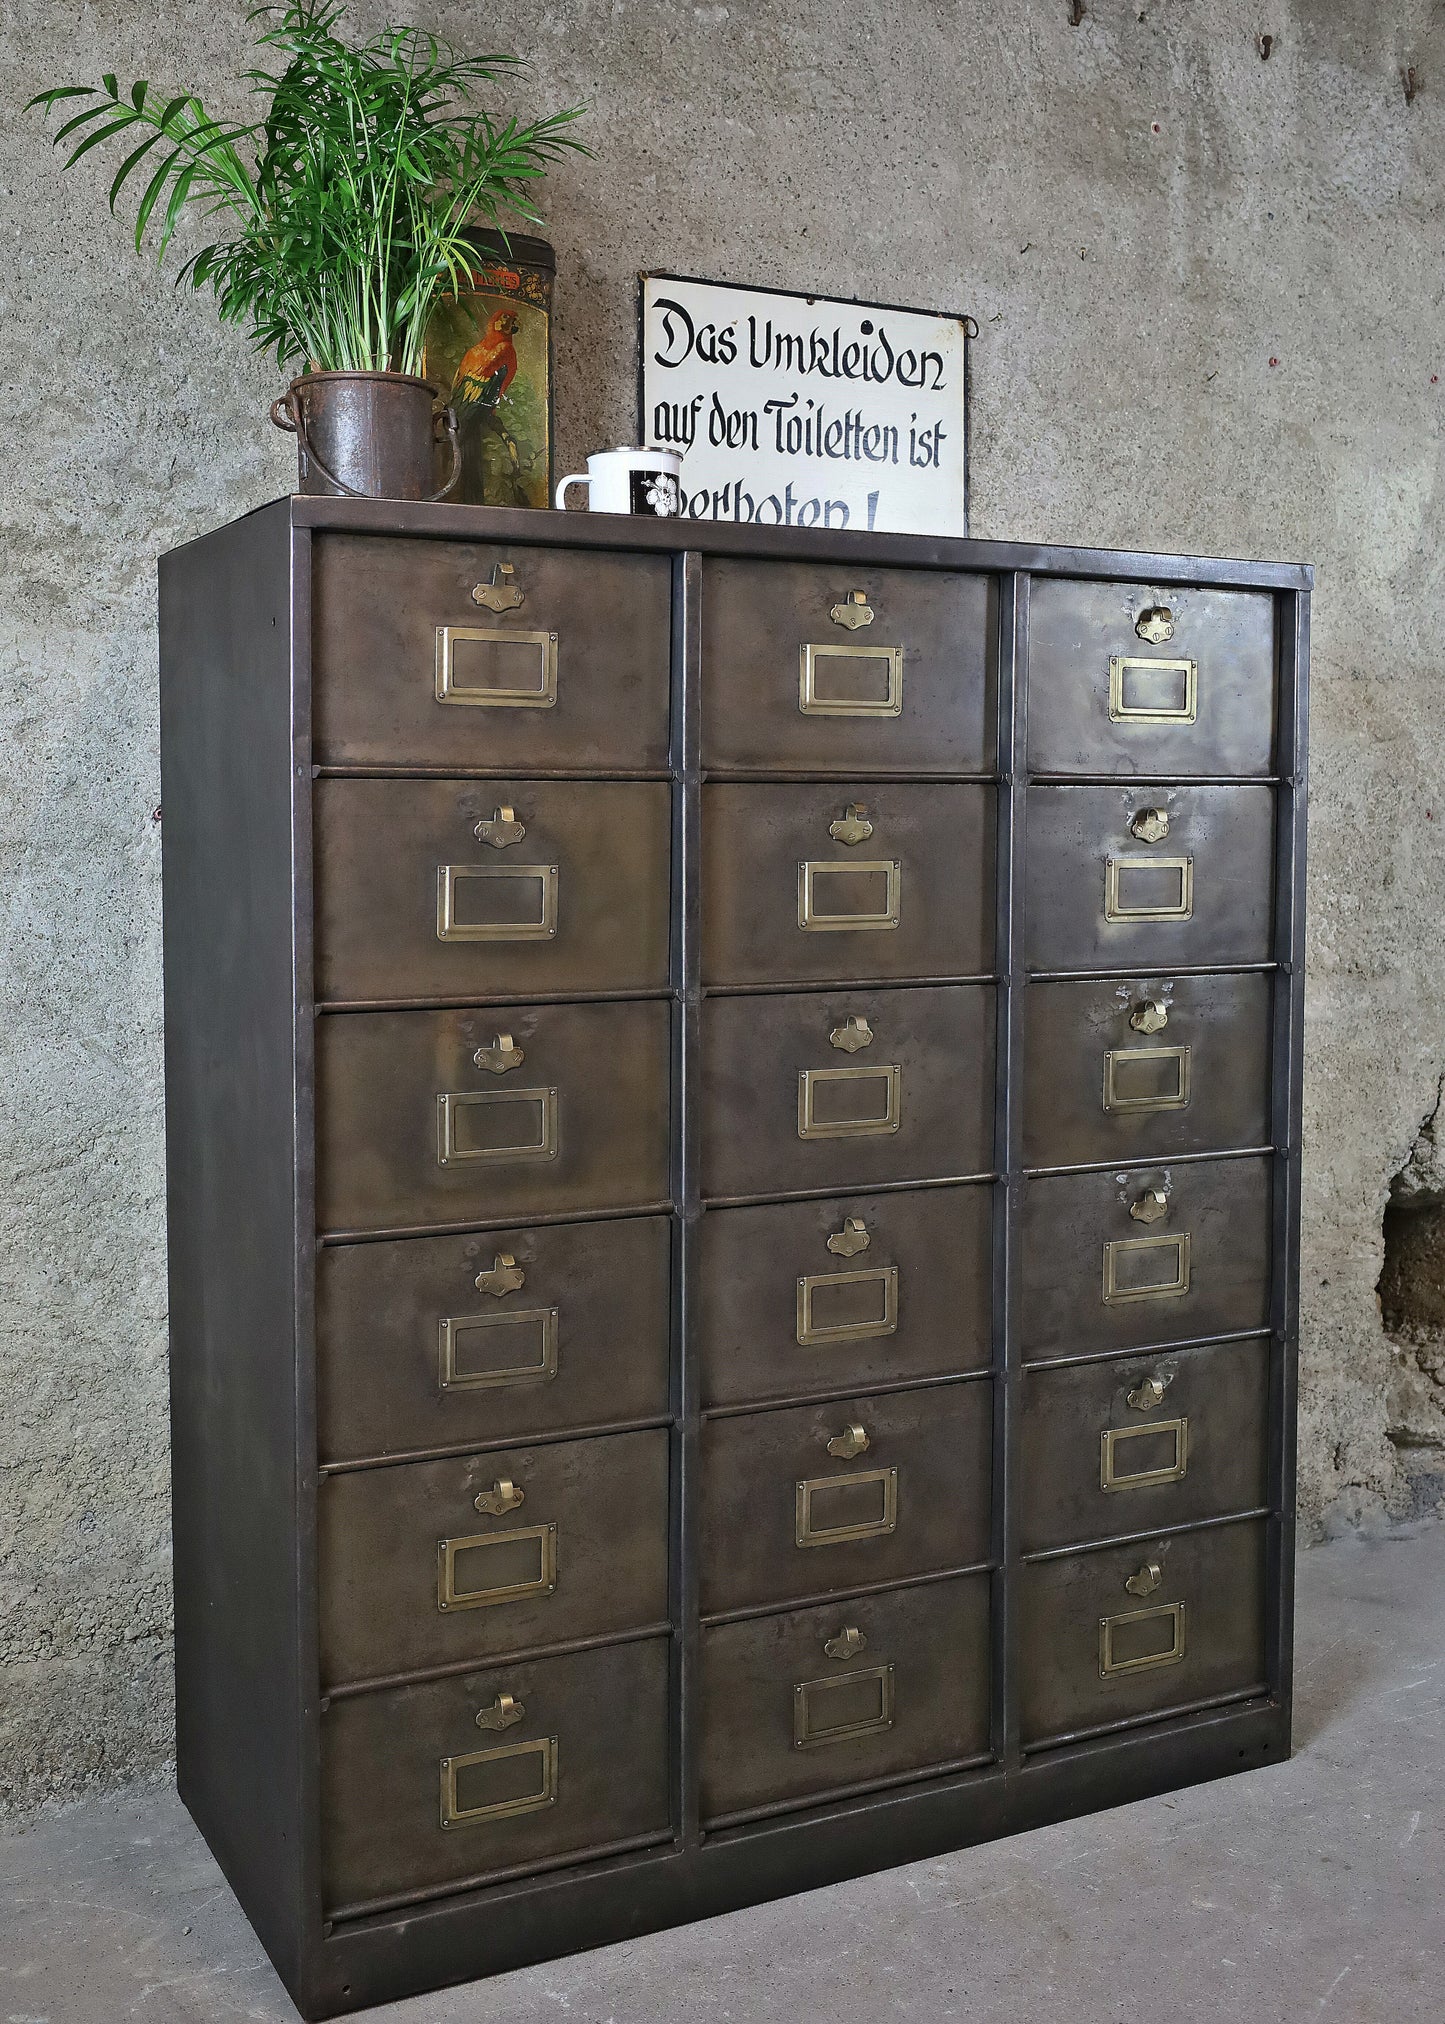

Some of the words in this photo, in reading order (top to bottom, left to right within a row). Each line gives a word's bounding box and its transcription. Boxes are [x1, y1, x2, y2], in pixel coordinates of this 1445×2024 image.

[651, 297, 738, 369] Das
[747, 315, 948, 391] Umkleiden
[653, 392, 705, 454] auf
[708, 390, 760, 452] den
[764, 391, 899, 465] Toiletten
[909, 412, 948, 469] ist
